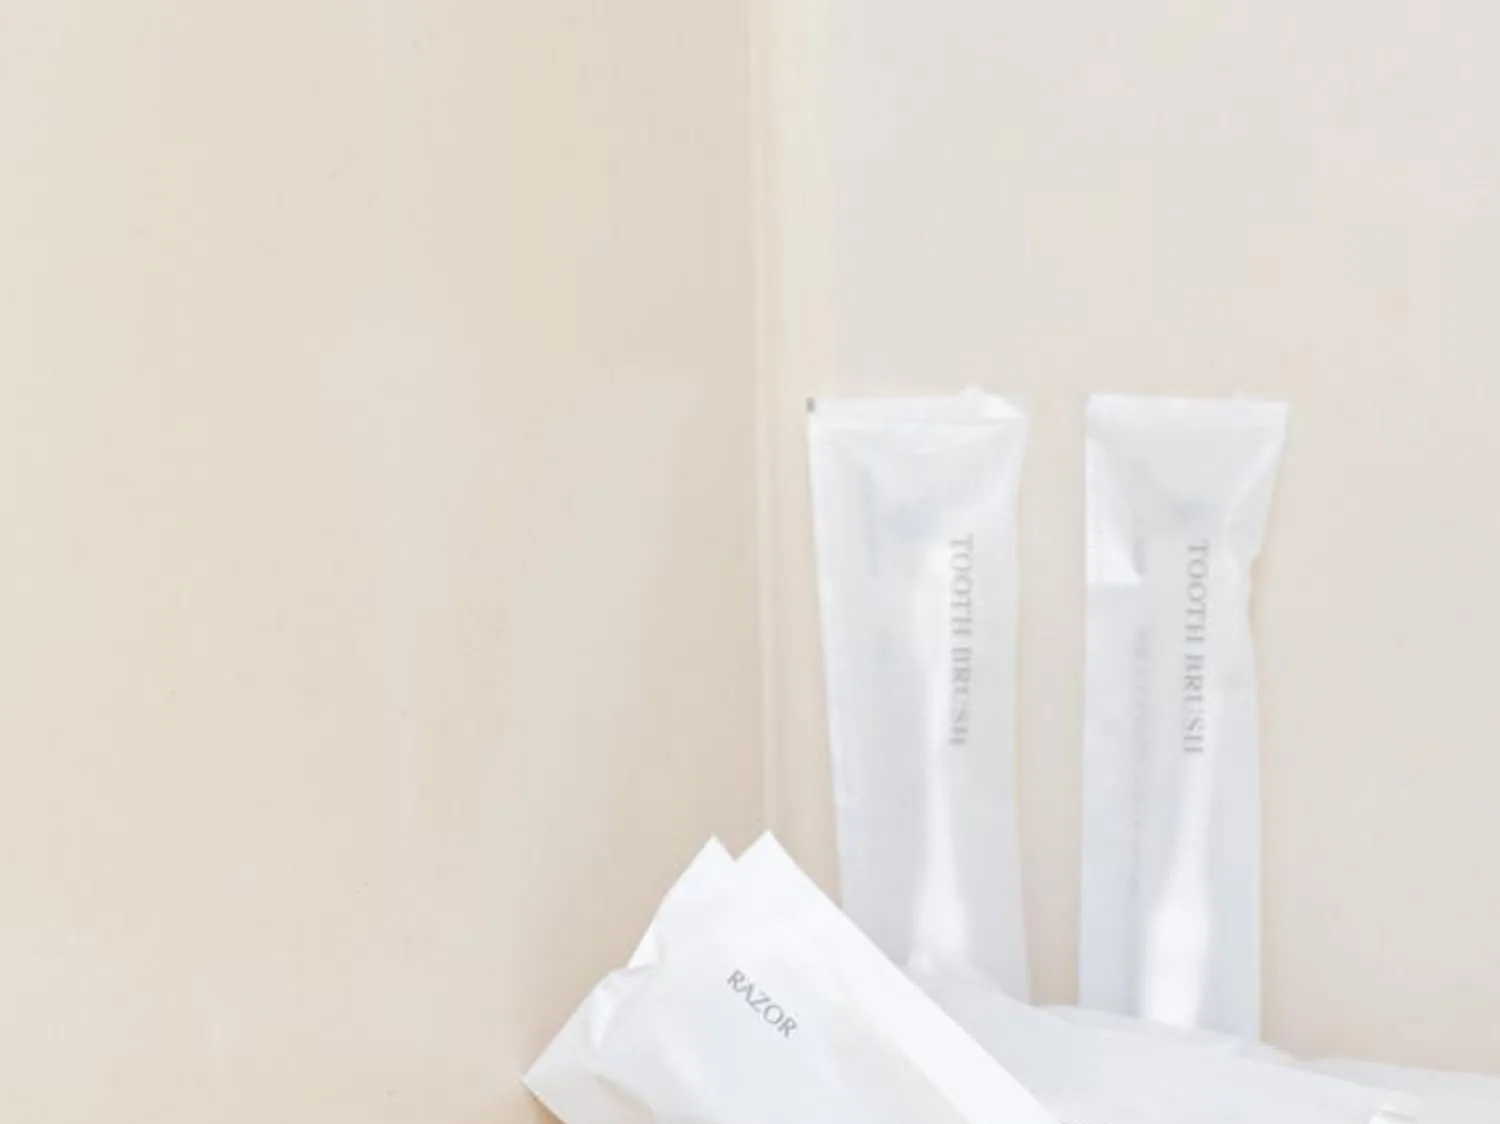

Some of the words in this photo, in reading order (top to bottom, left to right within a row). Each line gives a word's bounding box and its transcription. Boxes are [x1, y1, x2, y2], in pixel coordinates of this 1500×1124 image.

[950, 535, 974, 636] TOOTH
[1185, 540, 1208, 643] TOOTH
[950, 647, 972, 746] BRUSH
[1183, 654, 1205, 754] BRUSH
[726, 968, 798, 1039] RAZOR
